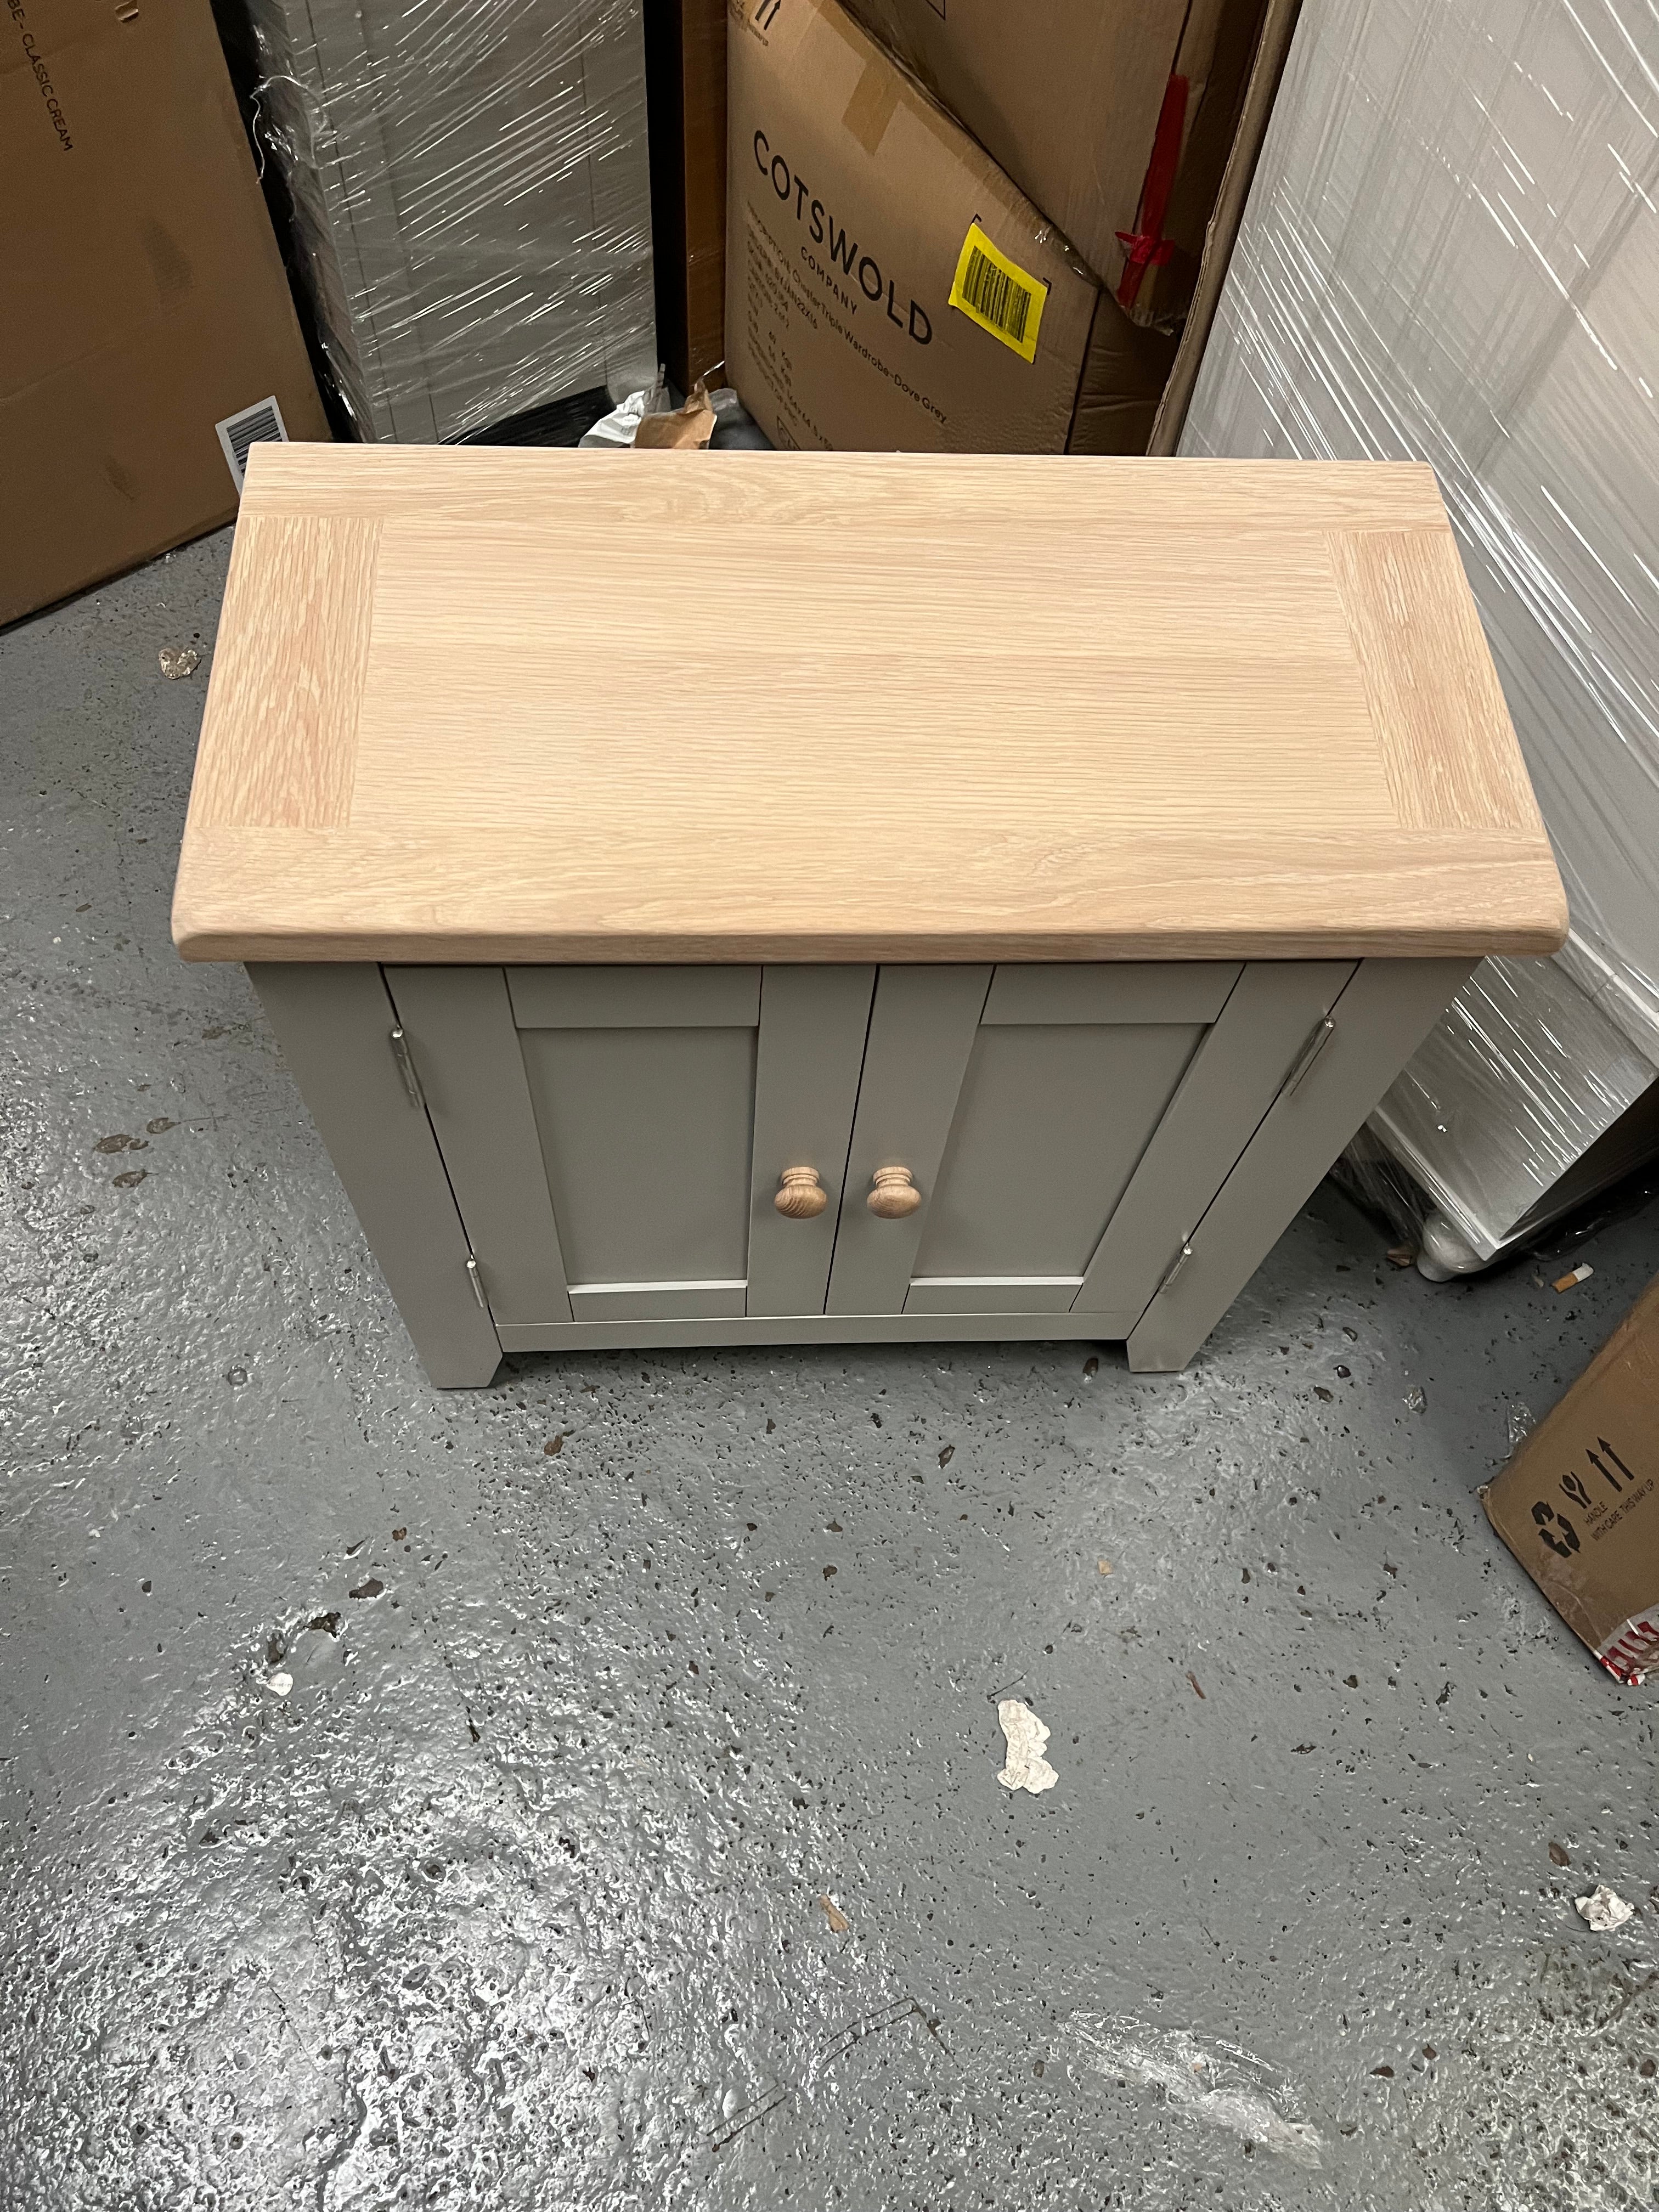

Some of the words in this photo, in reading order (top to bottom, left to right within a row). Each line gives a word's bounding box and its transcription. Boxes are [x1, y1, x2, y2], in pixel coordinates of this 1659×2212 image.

[22, 33, 54, 98] CLASSIC
[46, 98, 74, 151] CREAM
[754, 130, 933, 345] COTSWOLD
[800, 246, 857, 315] COMPANY
[821, 302, 843, 334] Triple
[921, 397, 947, 425] Grey
[1583, 1500, 1609, 1527] HANDLE
[1590, 1523, 1609, 1542] WITH
[1604, 1509, 1623, 1530] CARE
[1618, 1497, 1637, 1515] THIS
[1631, 1487, 1646, 1503] WAY
[1645, 1478, 1654, 1492] UP
